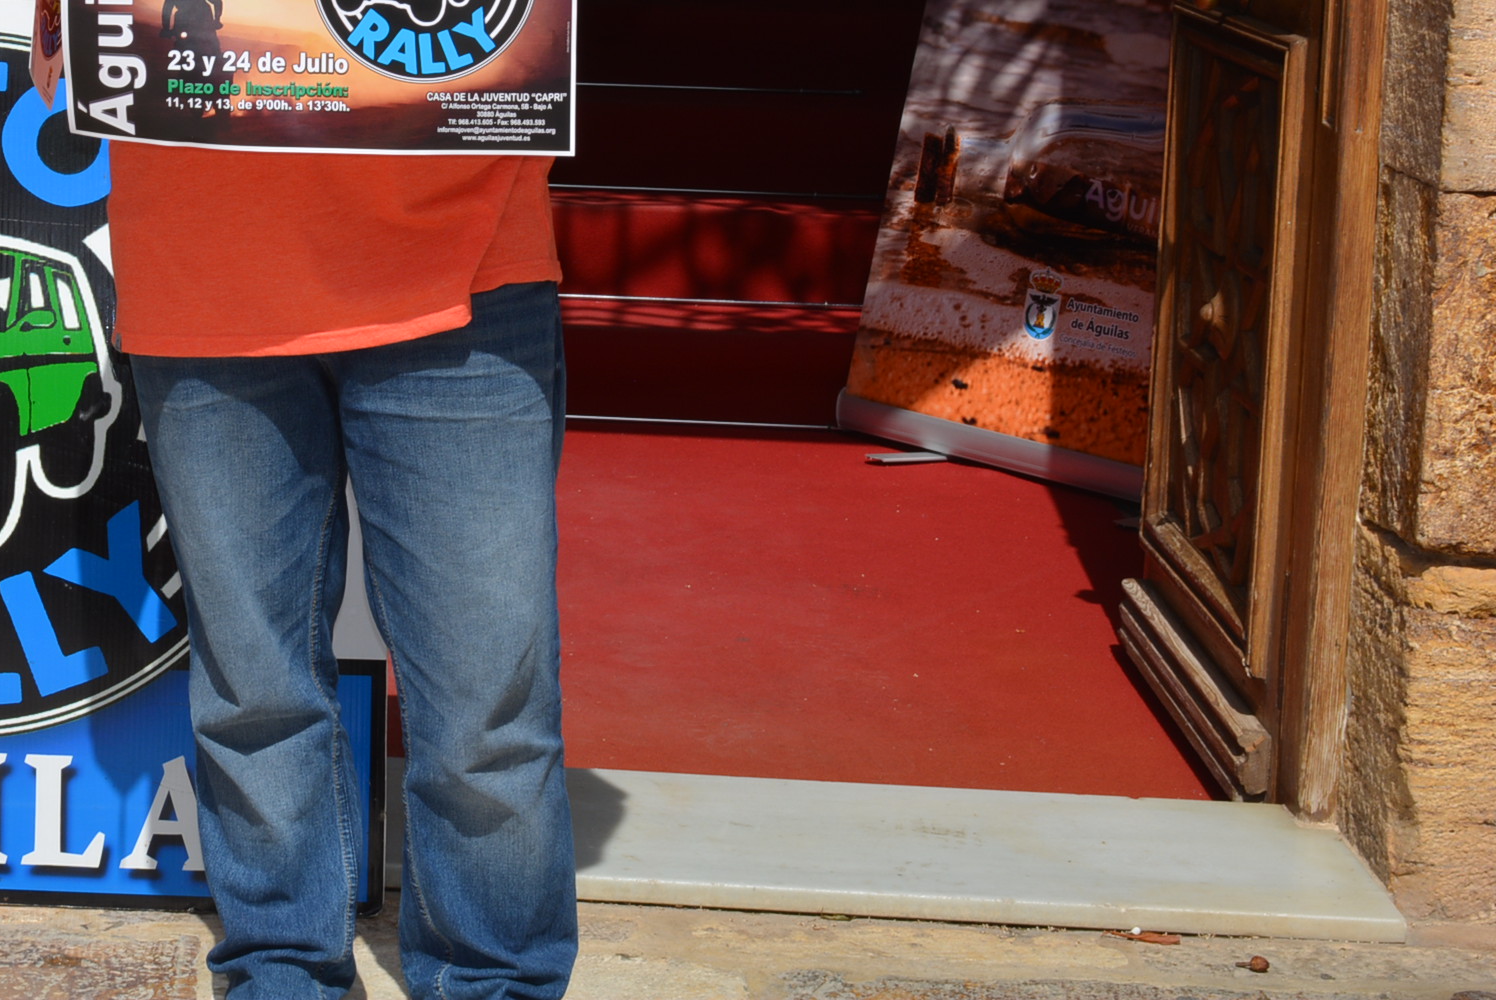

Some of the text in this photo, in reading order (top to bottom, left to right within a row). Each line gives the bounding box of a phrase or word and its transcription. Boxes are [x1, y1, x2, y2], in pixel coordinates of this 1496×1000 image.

[347, 6, 496, 76] RALLY
[166, 50, 350, 77] 23 y 24 de Julio
[167, 79, 350, 100] Plazo de Inscripción:
[426, 92, 568, 102] CASA DE LA JUVENTUD "CAPRI"
[166, 97, 351, 112] 11, 12 y 13, de 9'00h. a 13'30h.
[471, 103, 492, 111] Ortega
[492, 103, 520, 111] Carmona,
[533, 103, 547, 111] Bajo
[495, 110, 517, 119] Águilas
[1067, 298, 1140, 323] Ayuntamiento
[1071, 317, 1130, 340] de Águilas
[1095, 341, 1106, 351] de
[1107, 344, 1137, 358] Festejos
